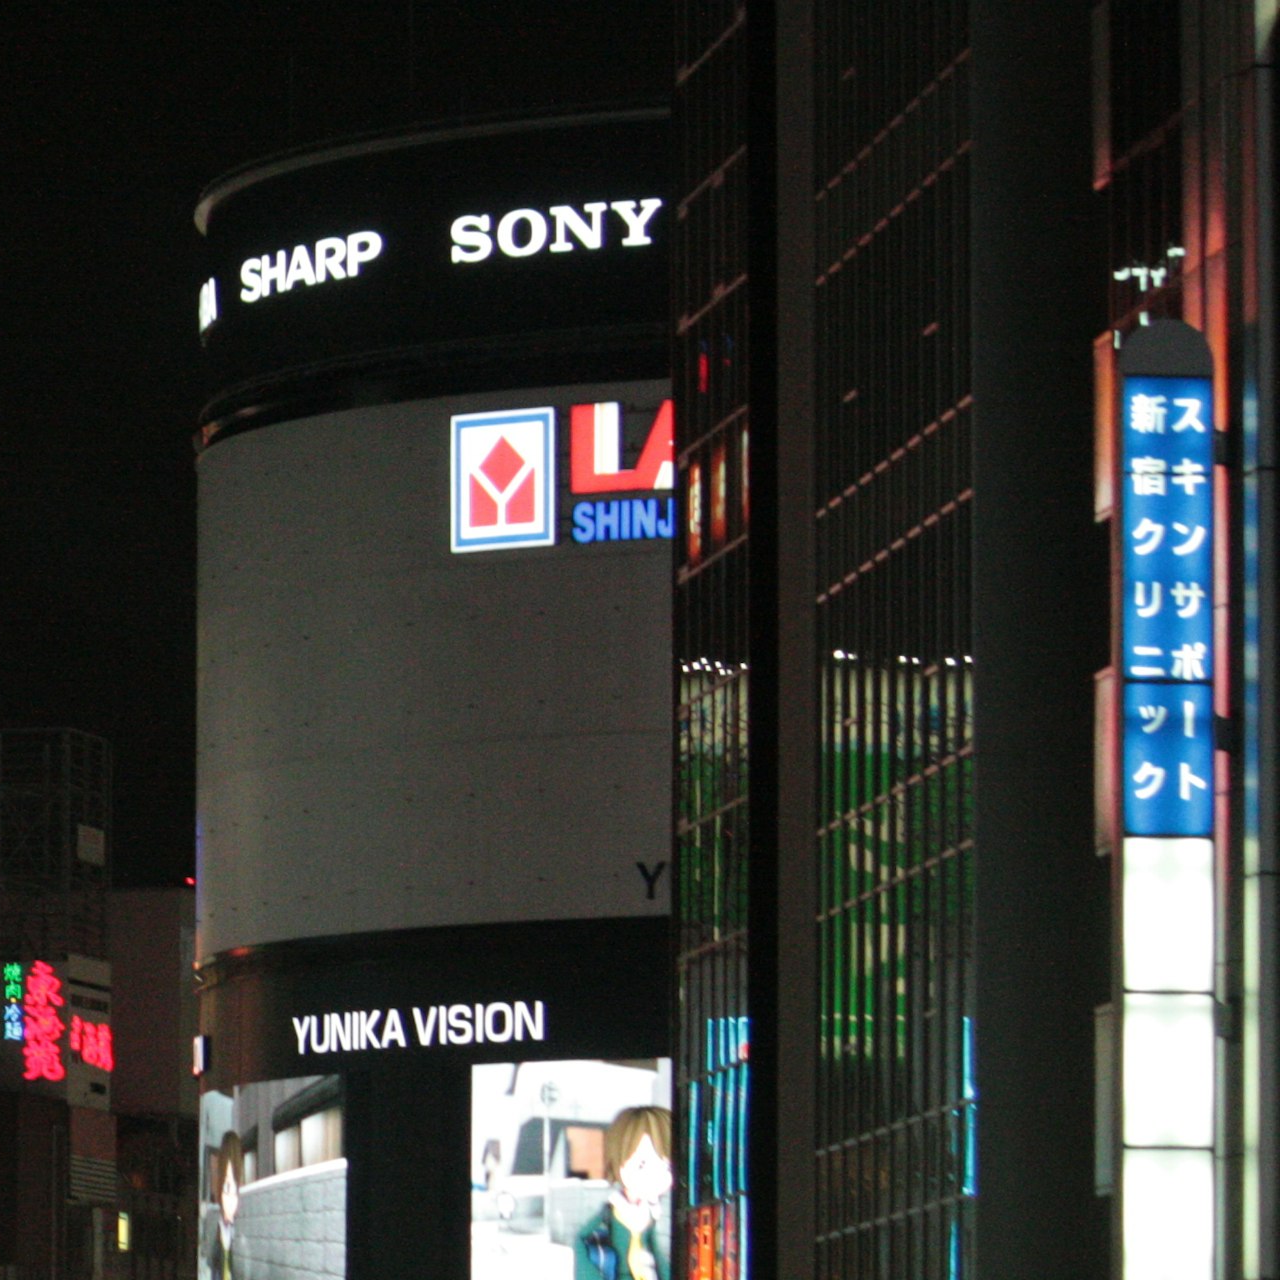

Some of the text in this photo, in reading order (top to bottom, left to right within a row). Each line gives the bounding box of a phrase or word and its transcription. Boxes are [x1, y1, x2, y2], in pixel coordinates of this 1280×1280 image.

[240, 230, 383, 303] SHARP
[450, 198, 662, 264] SONY
[1130, 393, 1168, 801] 新宿クリニック
[1171, 395, 1208, 802] スキンサポート
[292, 1000, 546, 1055] YUNIKA VISION
